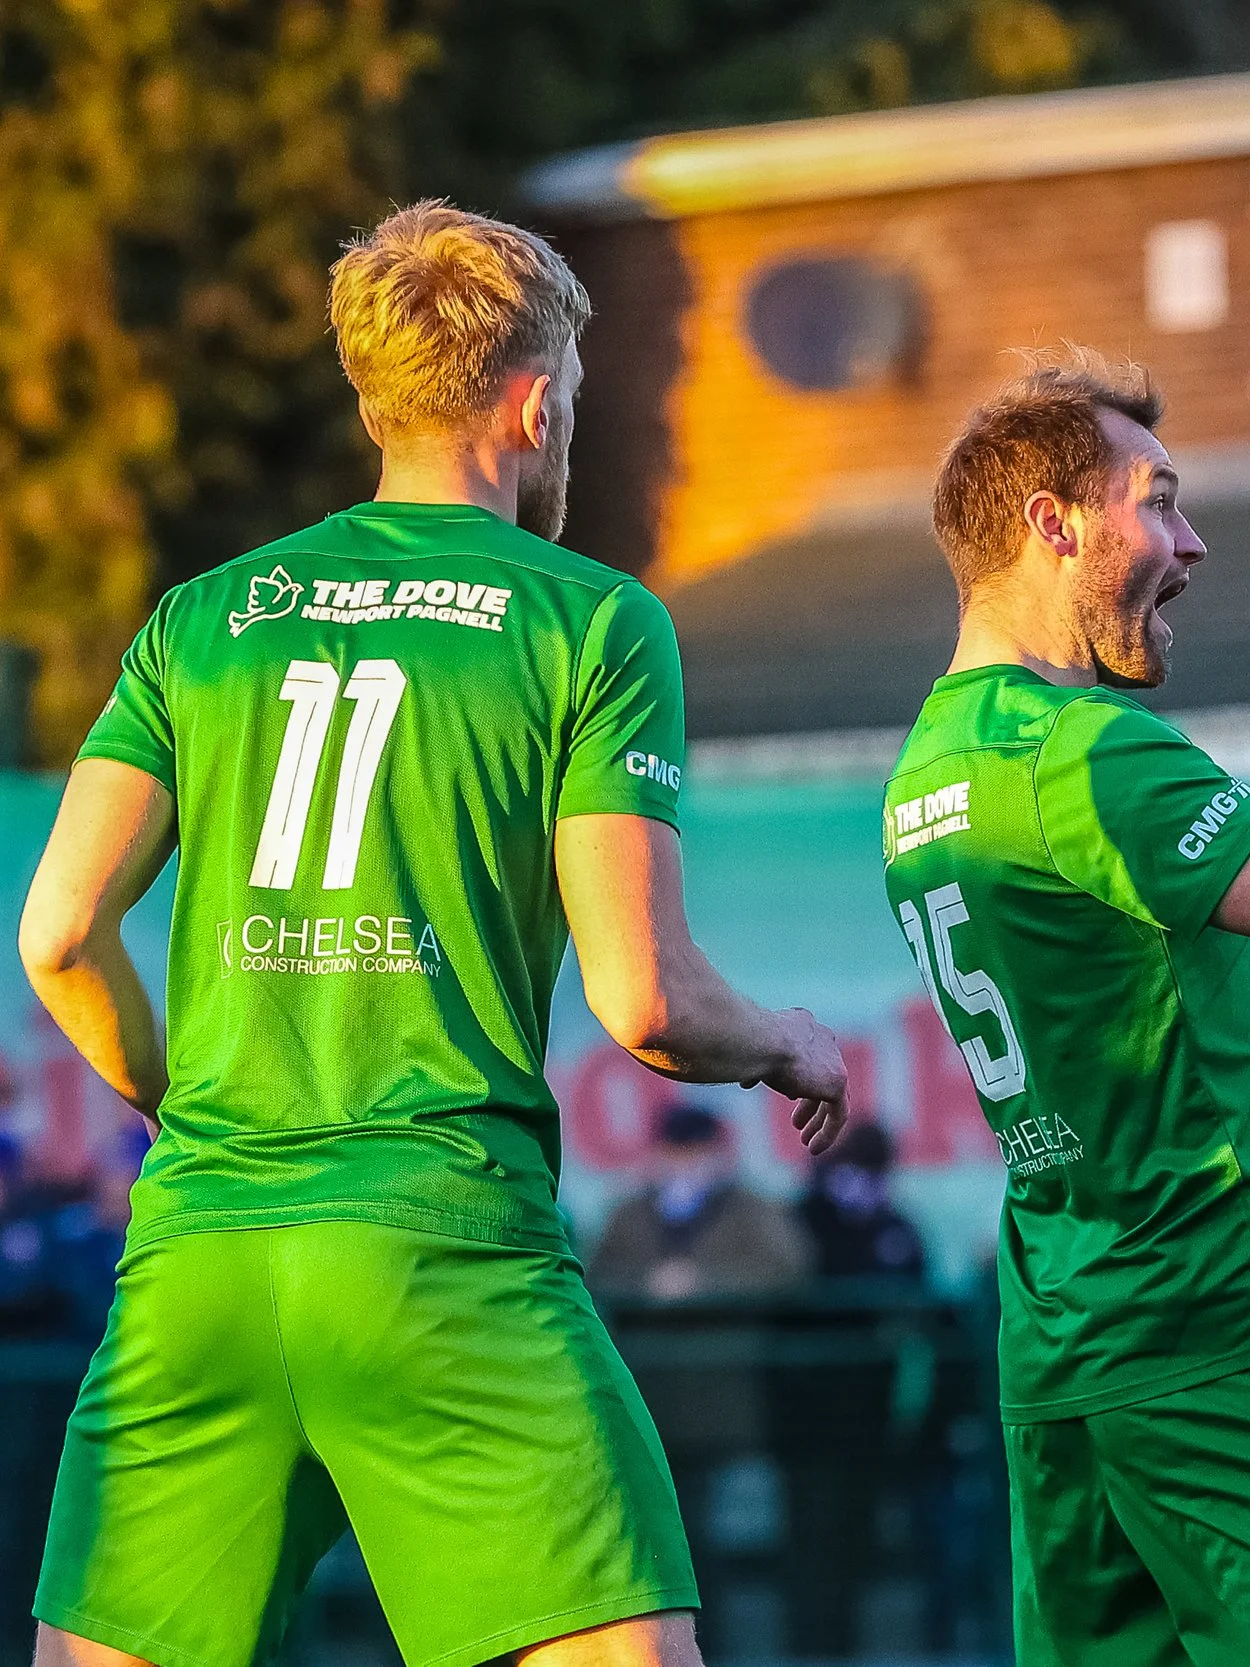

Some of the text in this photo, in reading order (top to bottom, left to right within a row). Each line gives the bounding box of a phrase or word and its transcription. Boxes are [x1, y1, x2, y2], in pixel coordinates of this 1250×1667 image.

[300, 604, 504, 632] NEWPORT PAGNELL
[310, 579, 513, 617] THE DOVE
[248, 658, 408, 891] 11
[625, 750, 681, 791] CMG
[894, 780, 971, 835] THE DOVE
[1178, 792, 1238, 860] CMG
[241, 914, 442, 962] CHELSEA
[240, 954, 442, 979] CONSTRUCTION COMPANY
[899, 882, 1027, 1102] 15
